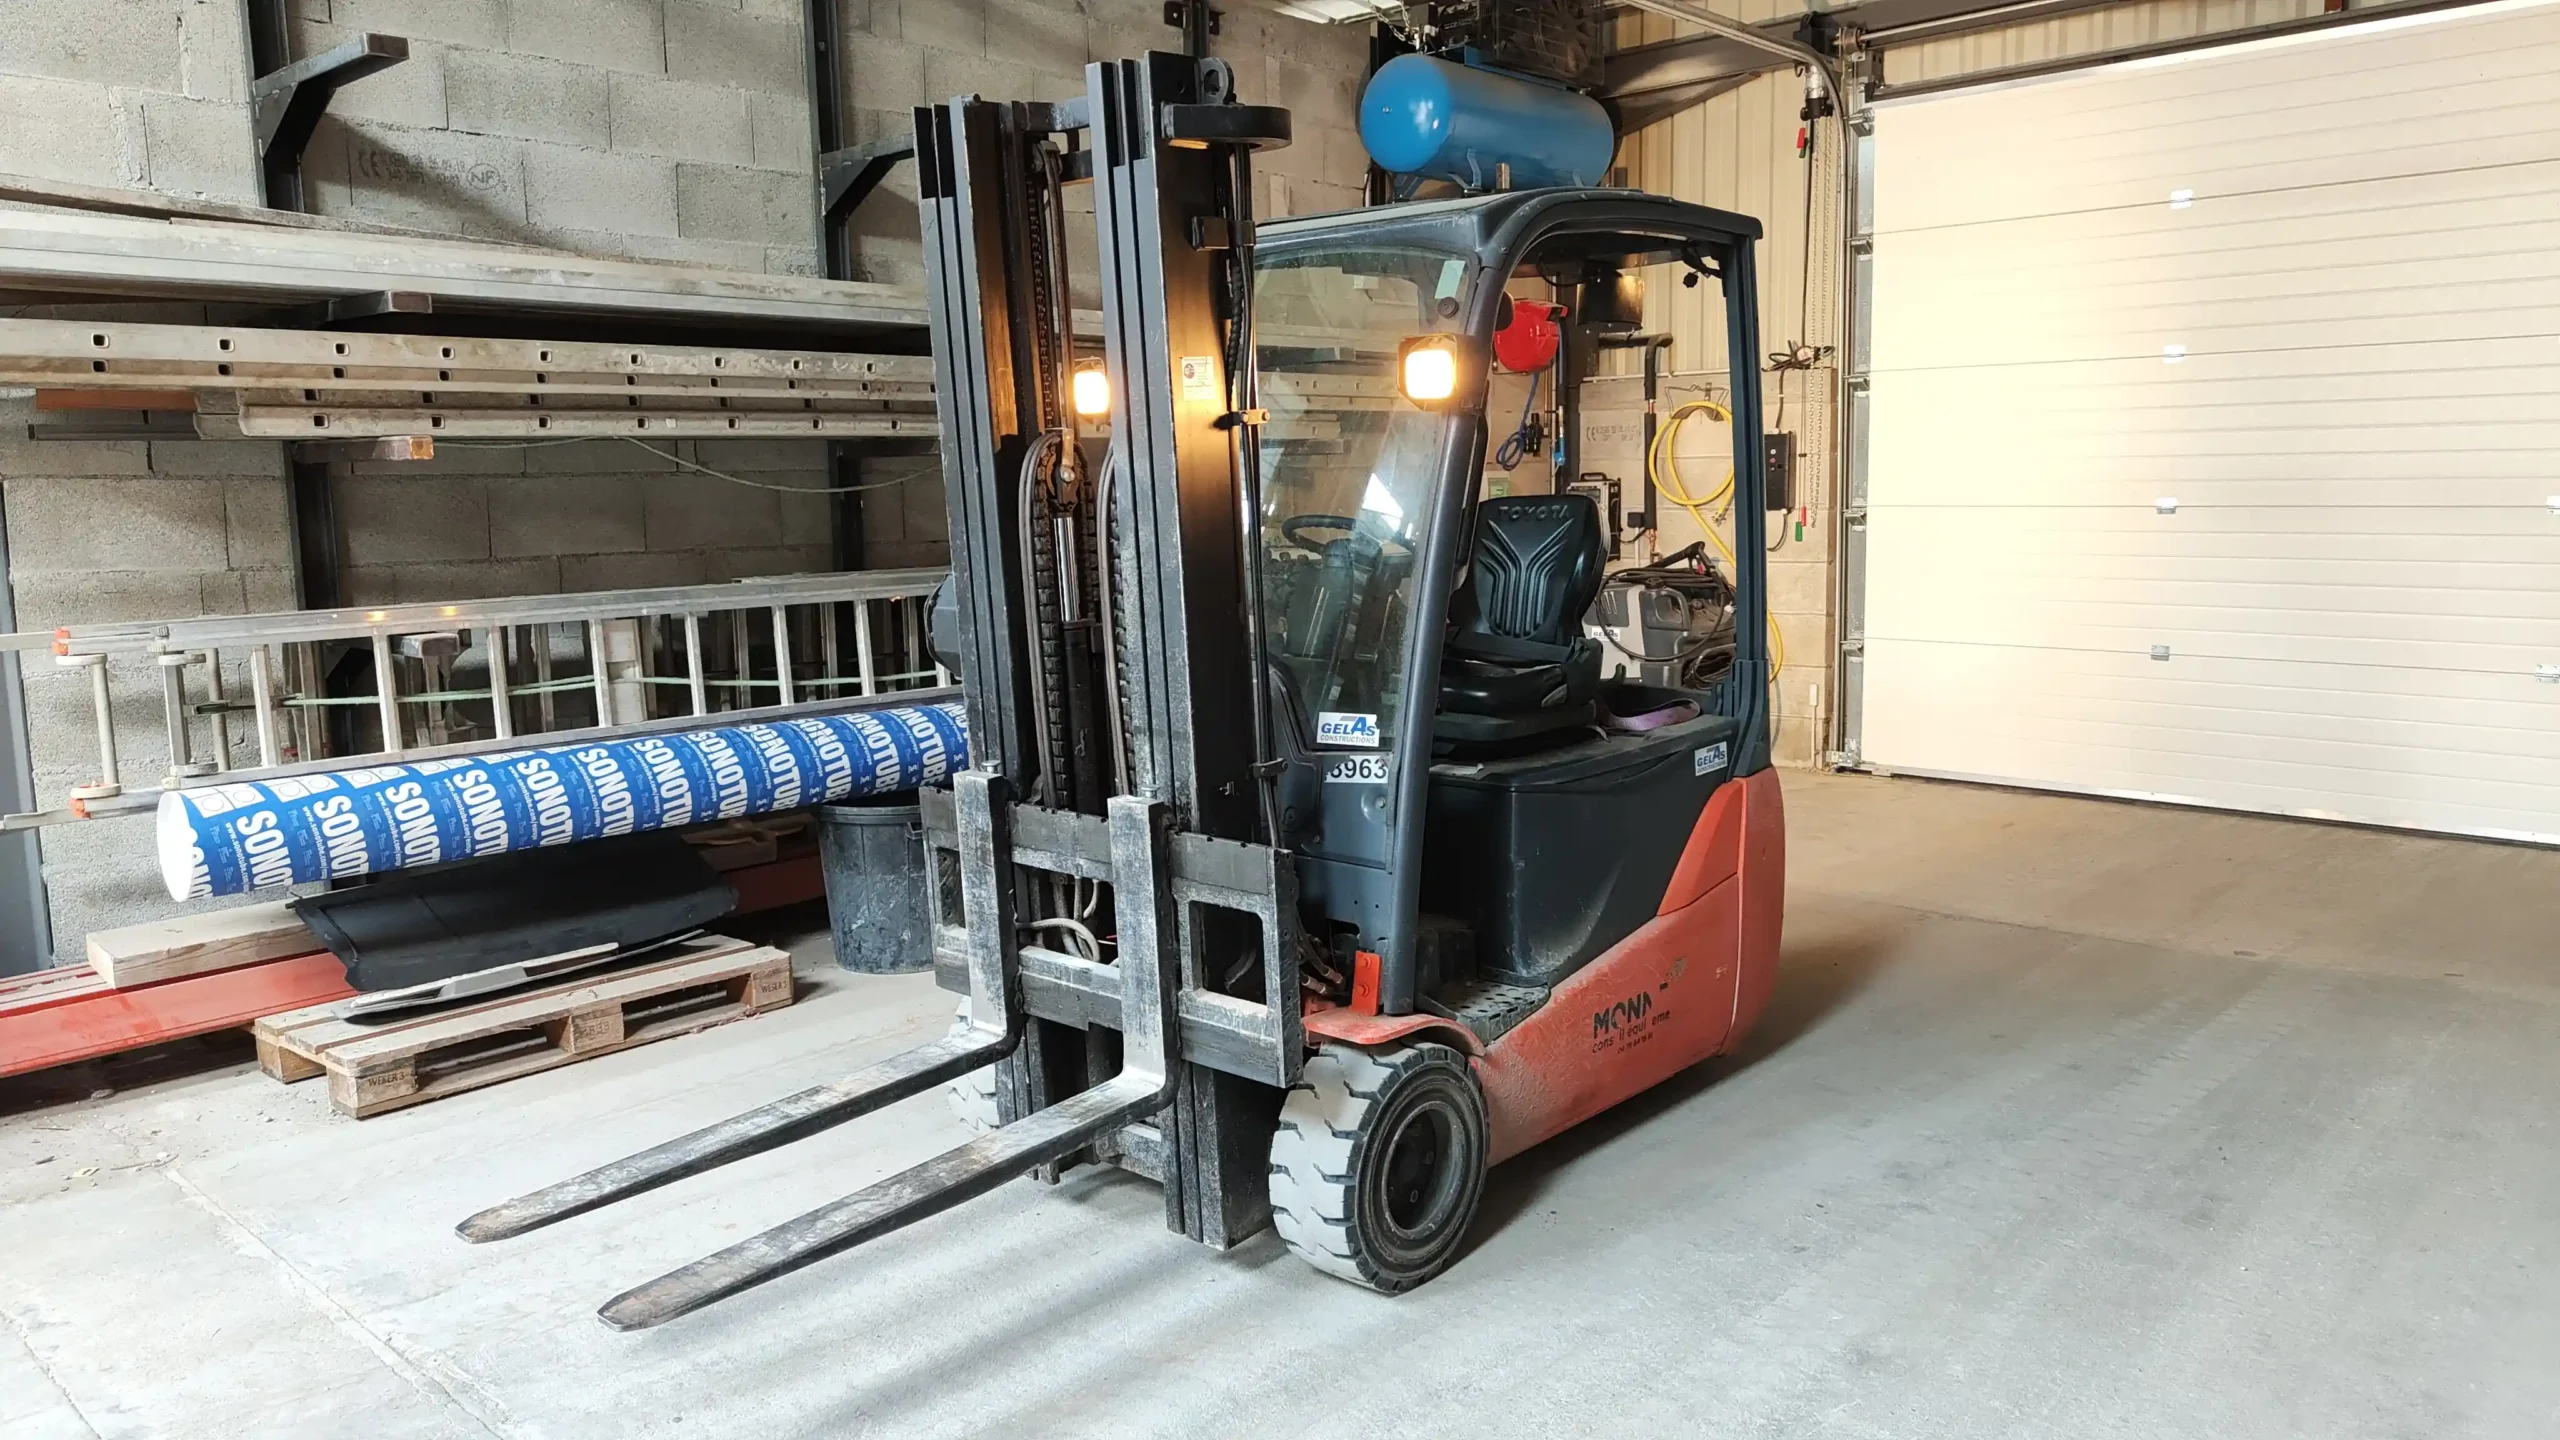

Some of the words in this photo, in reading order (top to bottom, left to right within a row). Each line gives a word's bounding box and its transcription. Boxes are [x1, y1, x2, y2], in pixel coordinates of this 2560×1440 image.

[1498, 504, 1570, 519] TOYOTA
[1321, 716, 1376, 737] GELAS
[1320, 735, 1376, 744] CONSTRUCTIONS
[1697, 745, 1726, 767] GELAS
